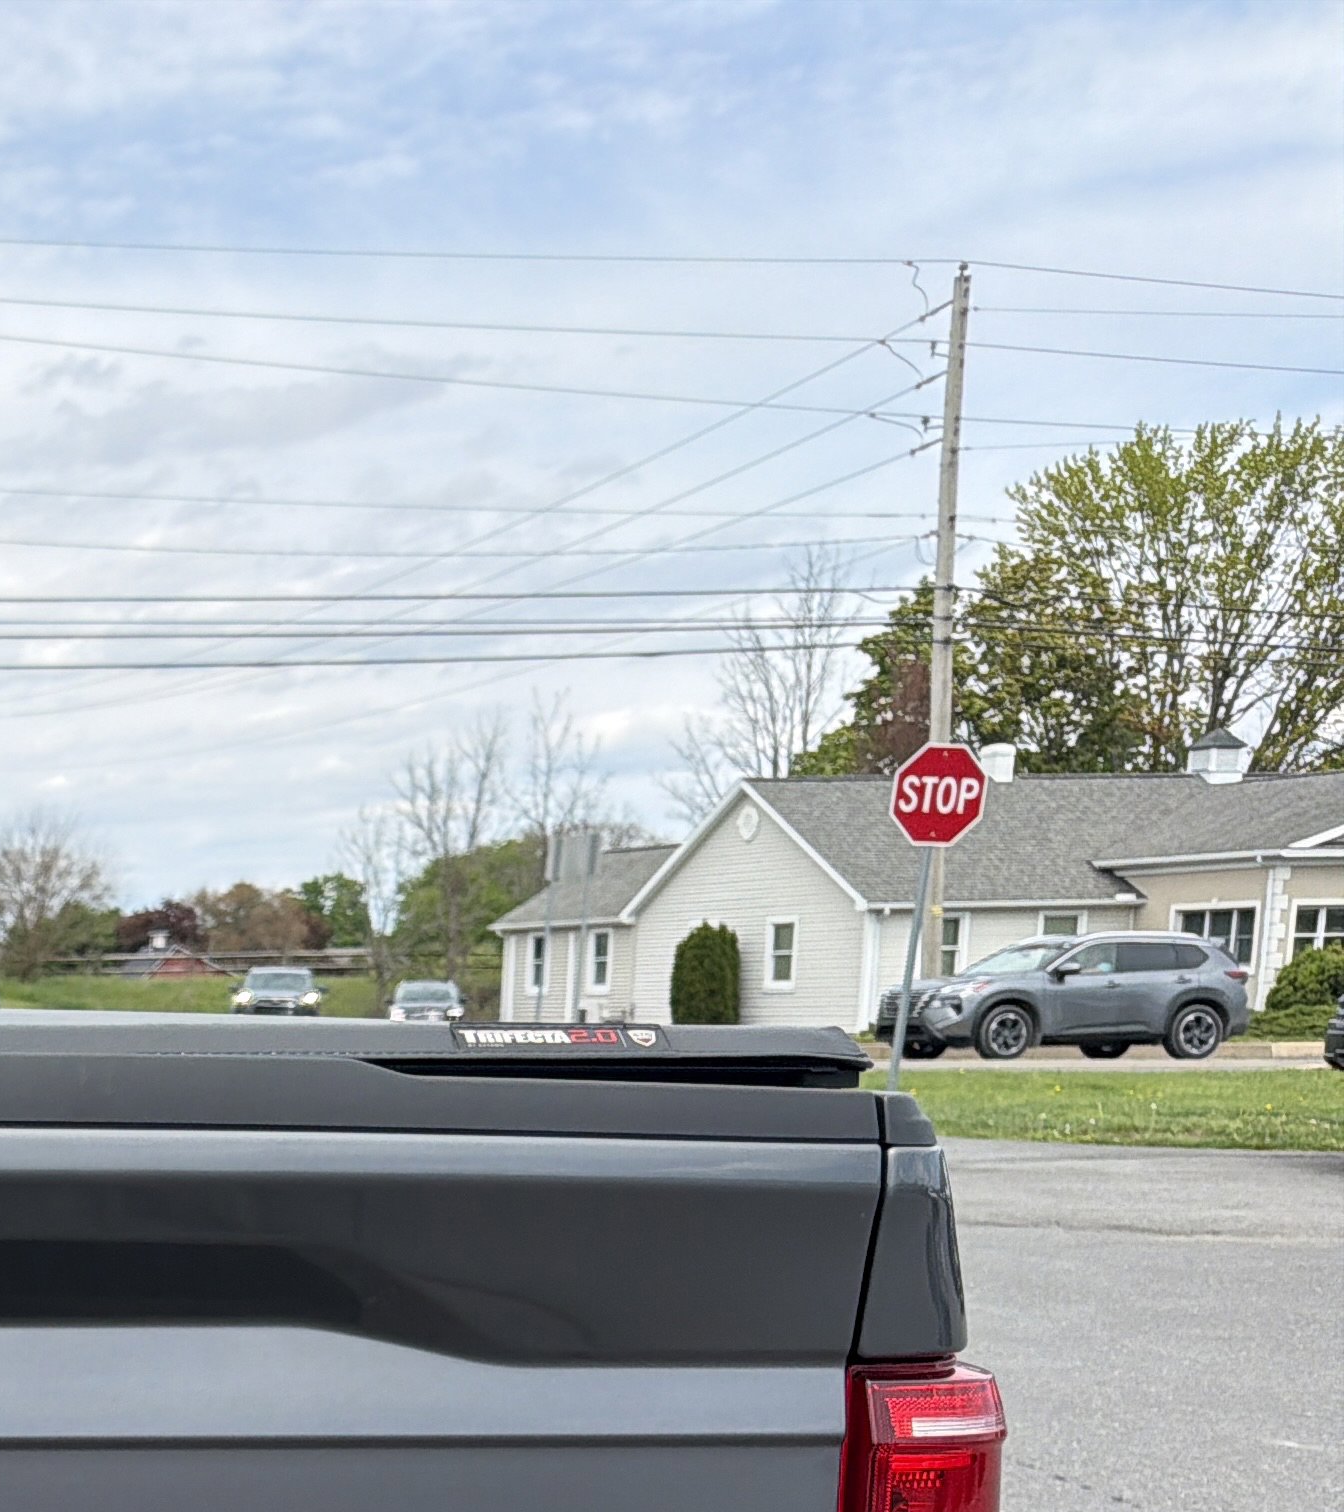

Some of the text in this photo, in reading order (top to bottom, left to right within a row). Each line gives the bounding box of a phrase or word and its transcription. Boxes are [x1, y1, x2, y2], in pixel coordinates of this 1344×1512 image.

[898, 775, 980, 814] STOP
[458, 1029, 572, 1044] TRIFECTA
[568, 1028, 619, 1045] 2.0
